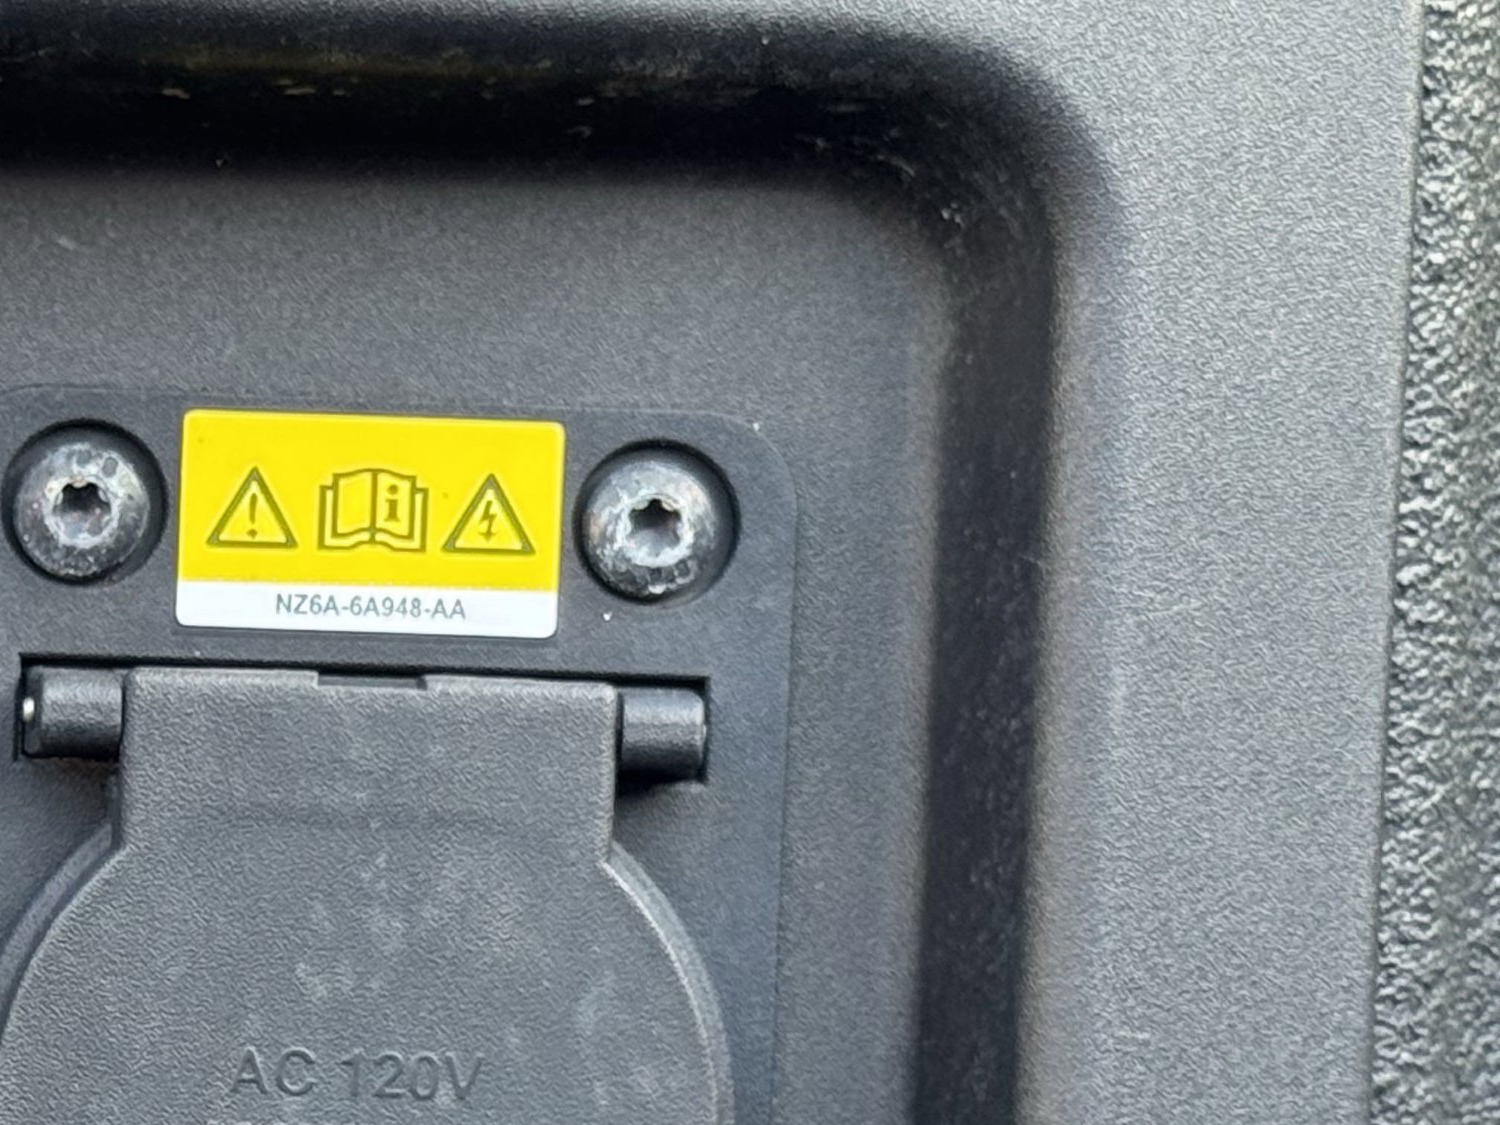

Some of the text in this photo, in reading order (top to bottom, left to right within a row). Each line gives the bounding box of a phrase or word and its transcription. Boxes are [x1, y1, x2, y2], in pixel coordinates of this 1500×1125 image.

[275, 592, 467, 620] NZ6A-6A948-AA
[229, 1045, 484, 1101] AC 120V
